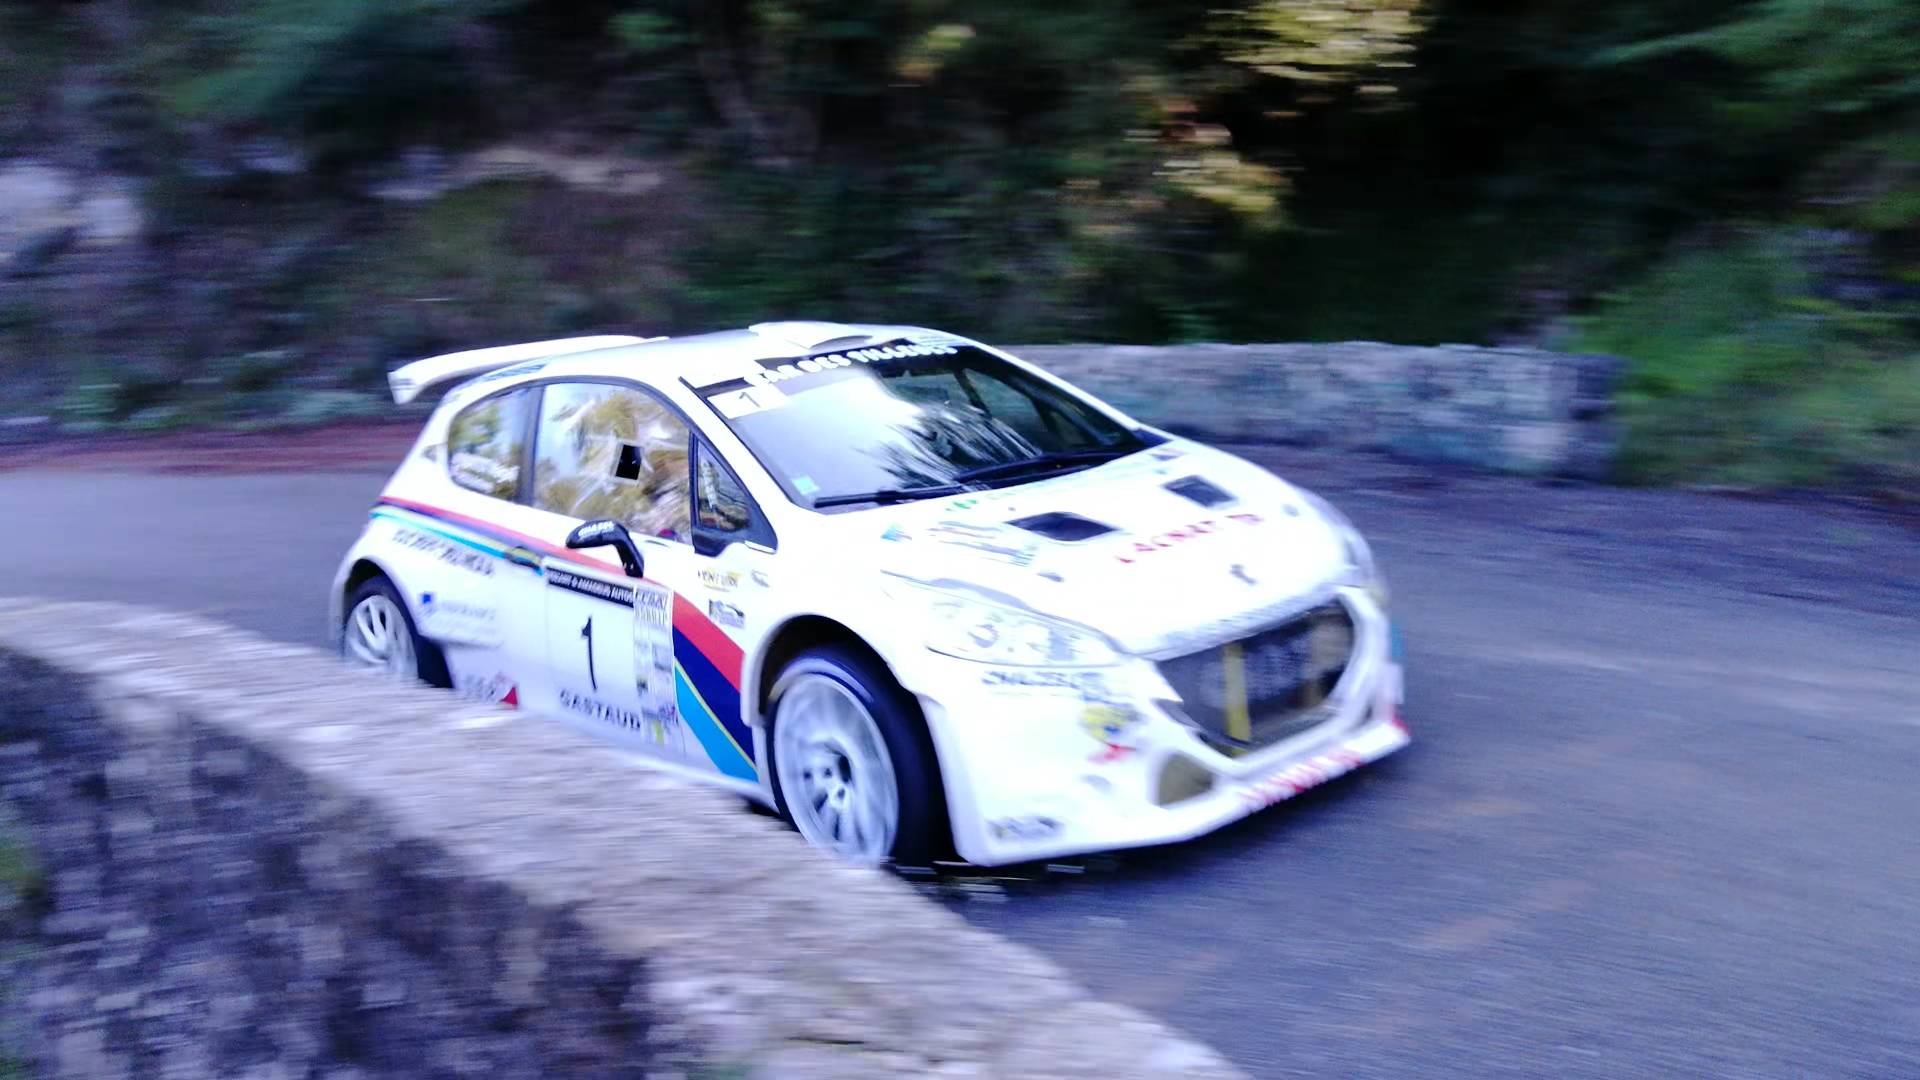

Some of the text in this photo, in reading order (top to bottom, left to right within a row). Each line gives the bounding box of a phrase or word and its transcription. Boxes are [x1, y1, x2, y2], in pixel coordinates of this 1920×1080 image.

[797, 354, 851, 373] DES
[581, 614, 598, 691] 1
[560, 689, 641, 730] GASTAUD
